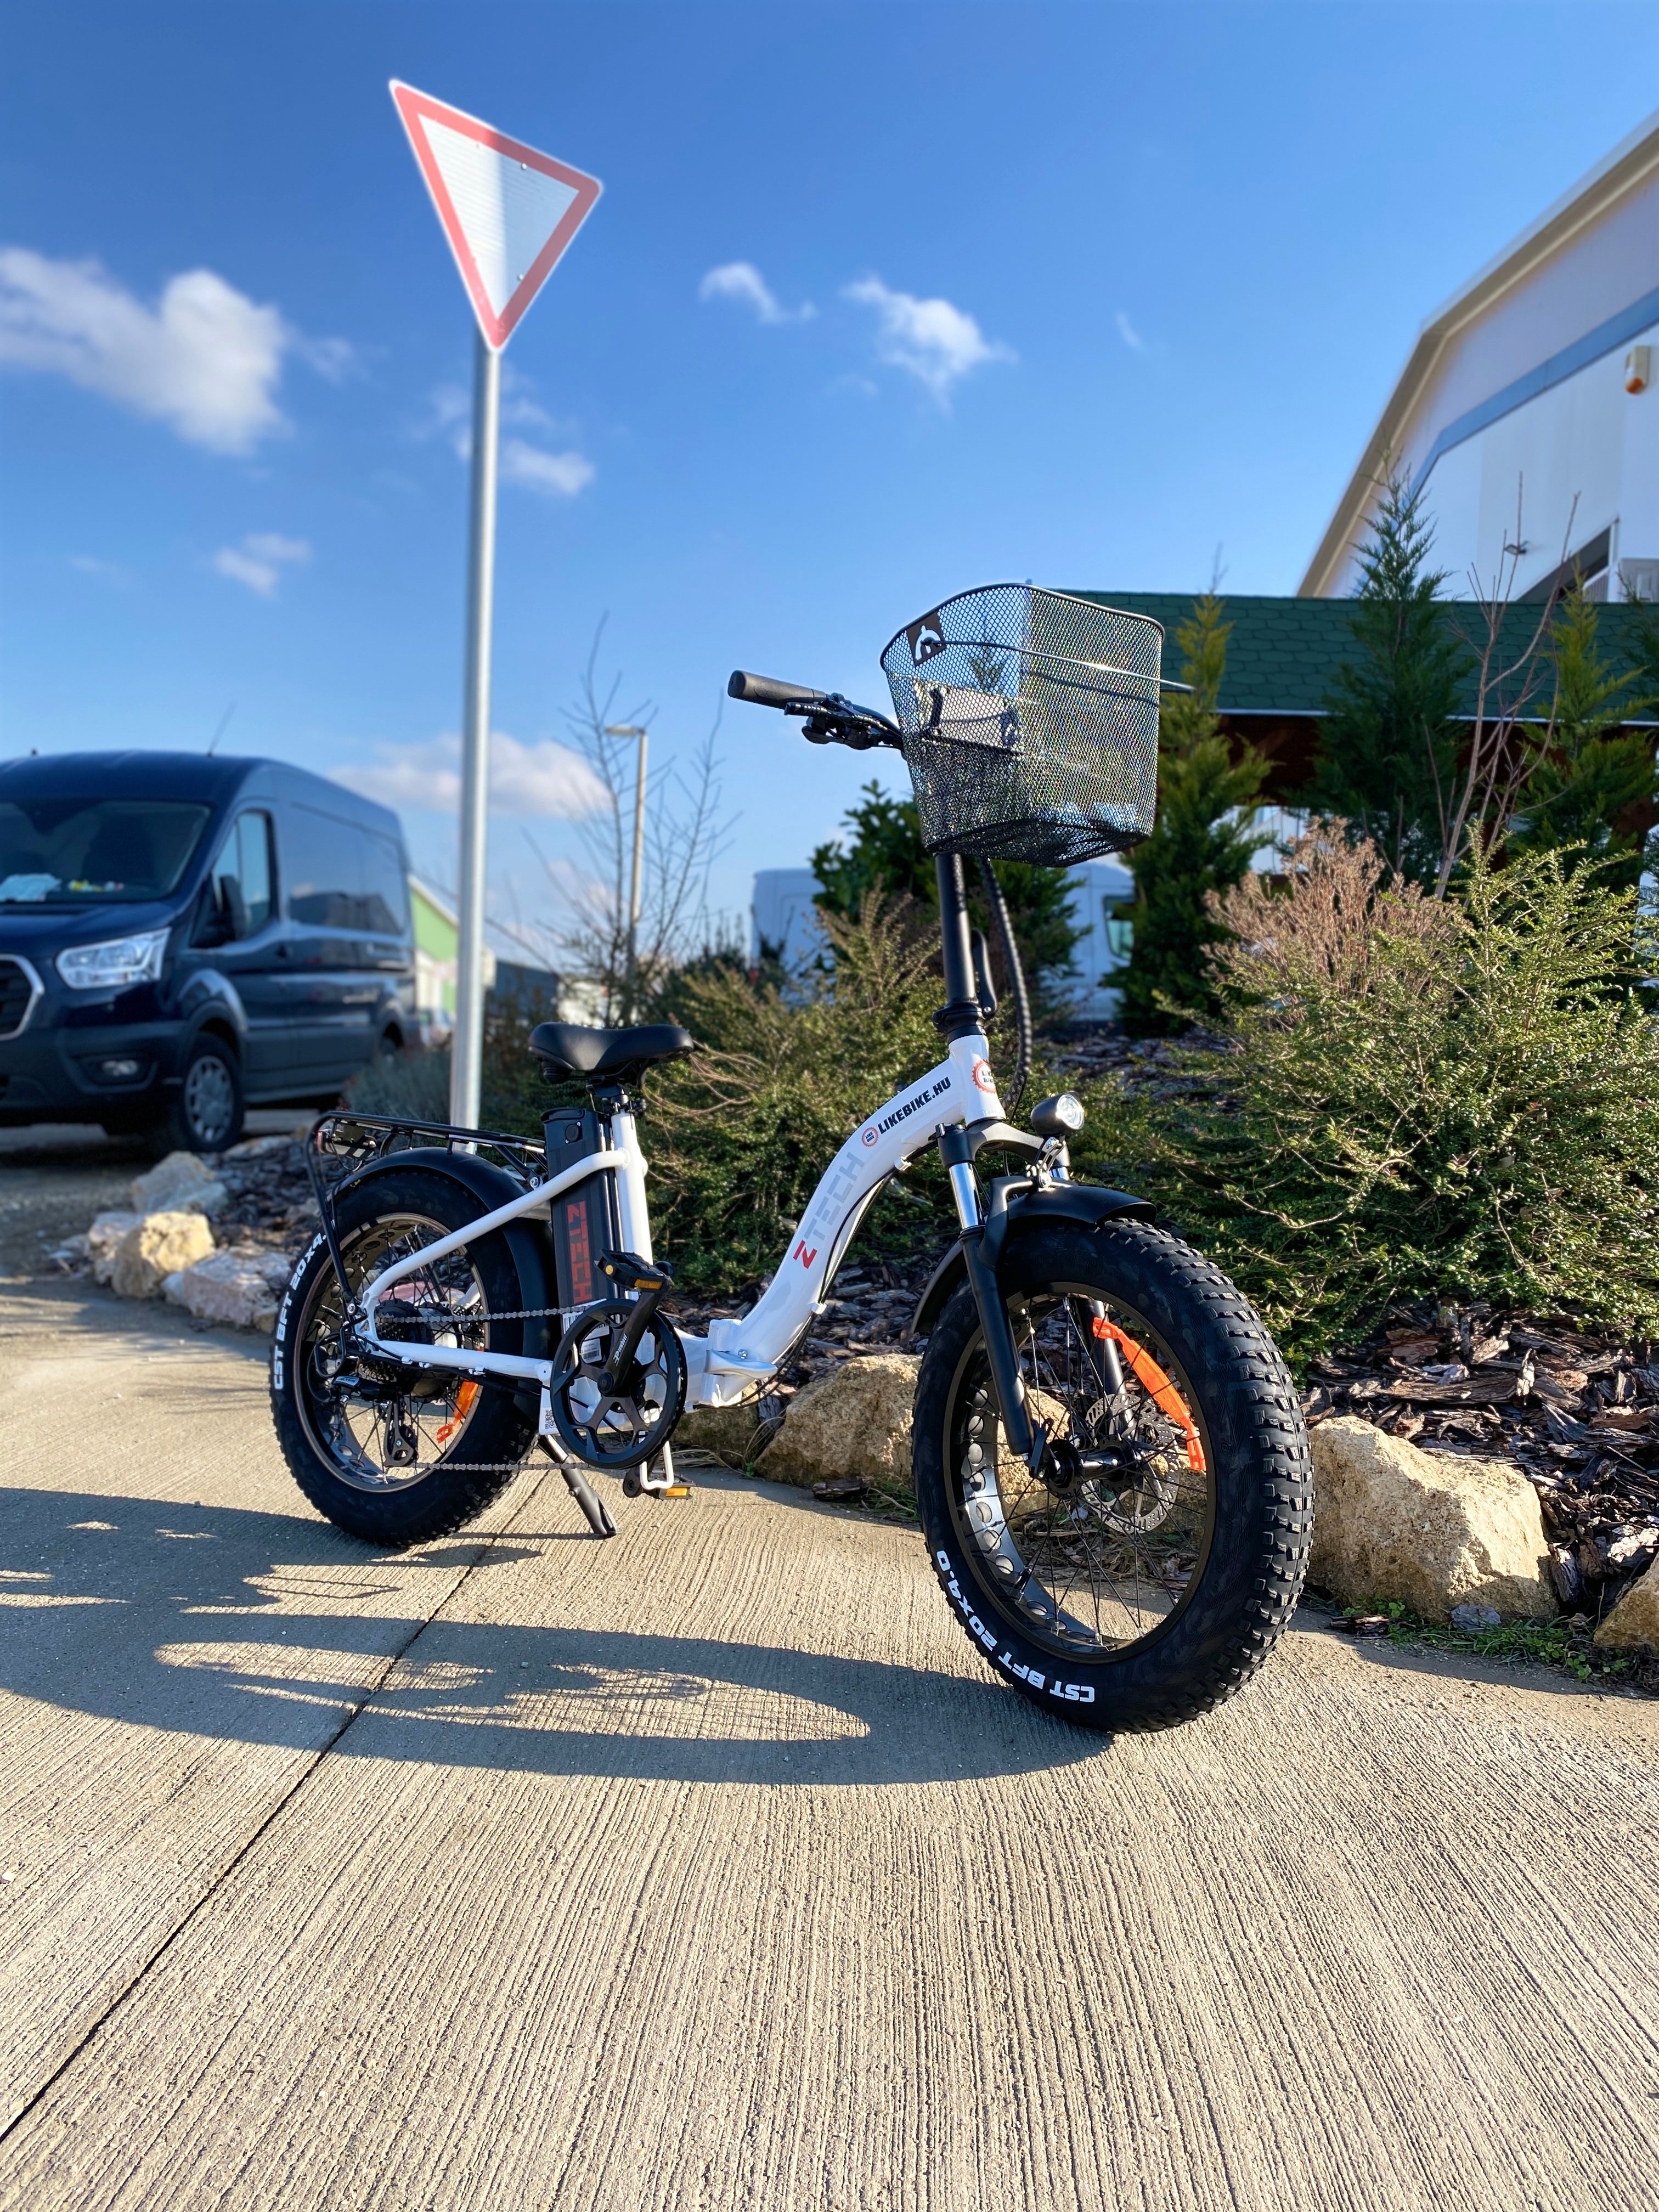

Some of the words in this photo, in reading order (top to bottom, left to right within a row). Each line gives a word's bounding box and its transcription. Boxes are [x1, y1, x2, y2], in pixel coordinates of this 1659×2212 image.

[878, 1076, 952, 1134] LIKEBIKE.HU
[793, 1152, 865, 1269] ZTECH
[290, 1232, 328, 1290] 20X4.
[567, 1200, 592, 1304] ZTECH
[276, 1291, 292, 1341] BFT
[274, 1345, 284, 1389] CST
[936, 1550, 998, 1651] 20X4.0
[998, 1651, 1046, 1690] BFT
[1049, 1681, 1095, 1703] CST
